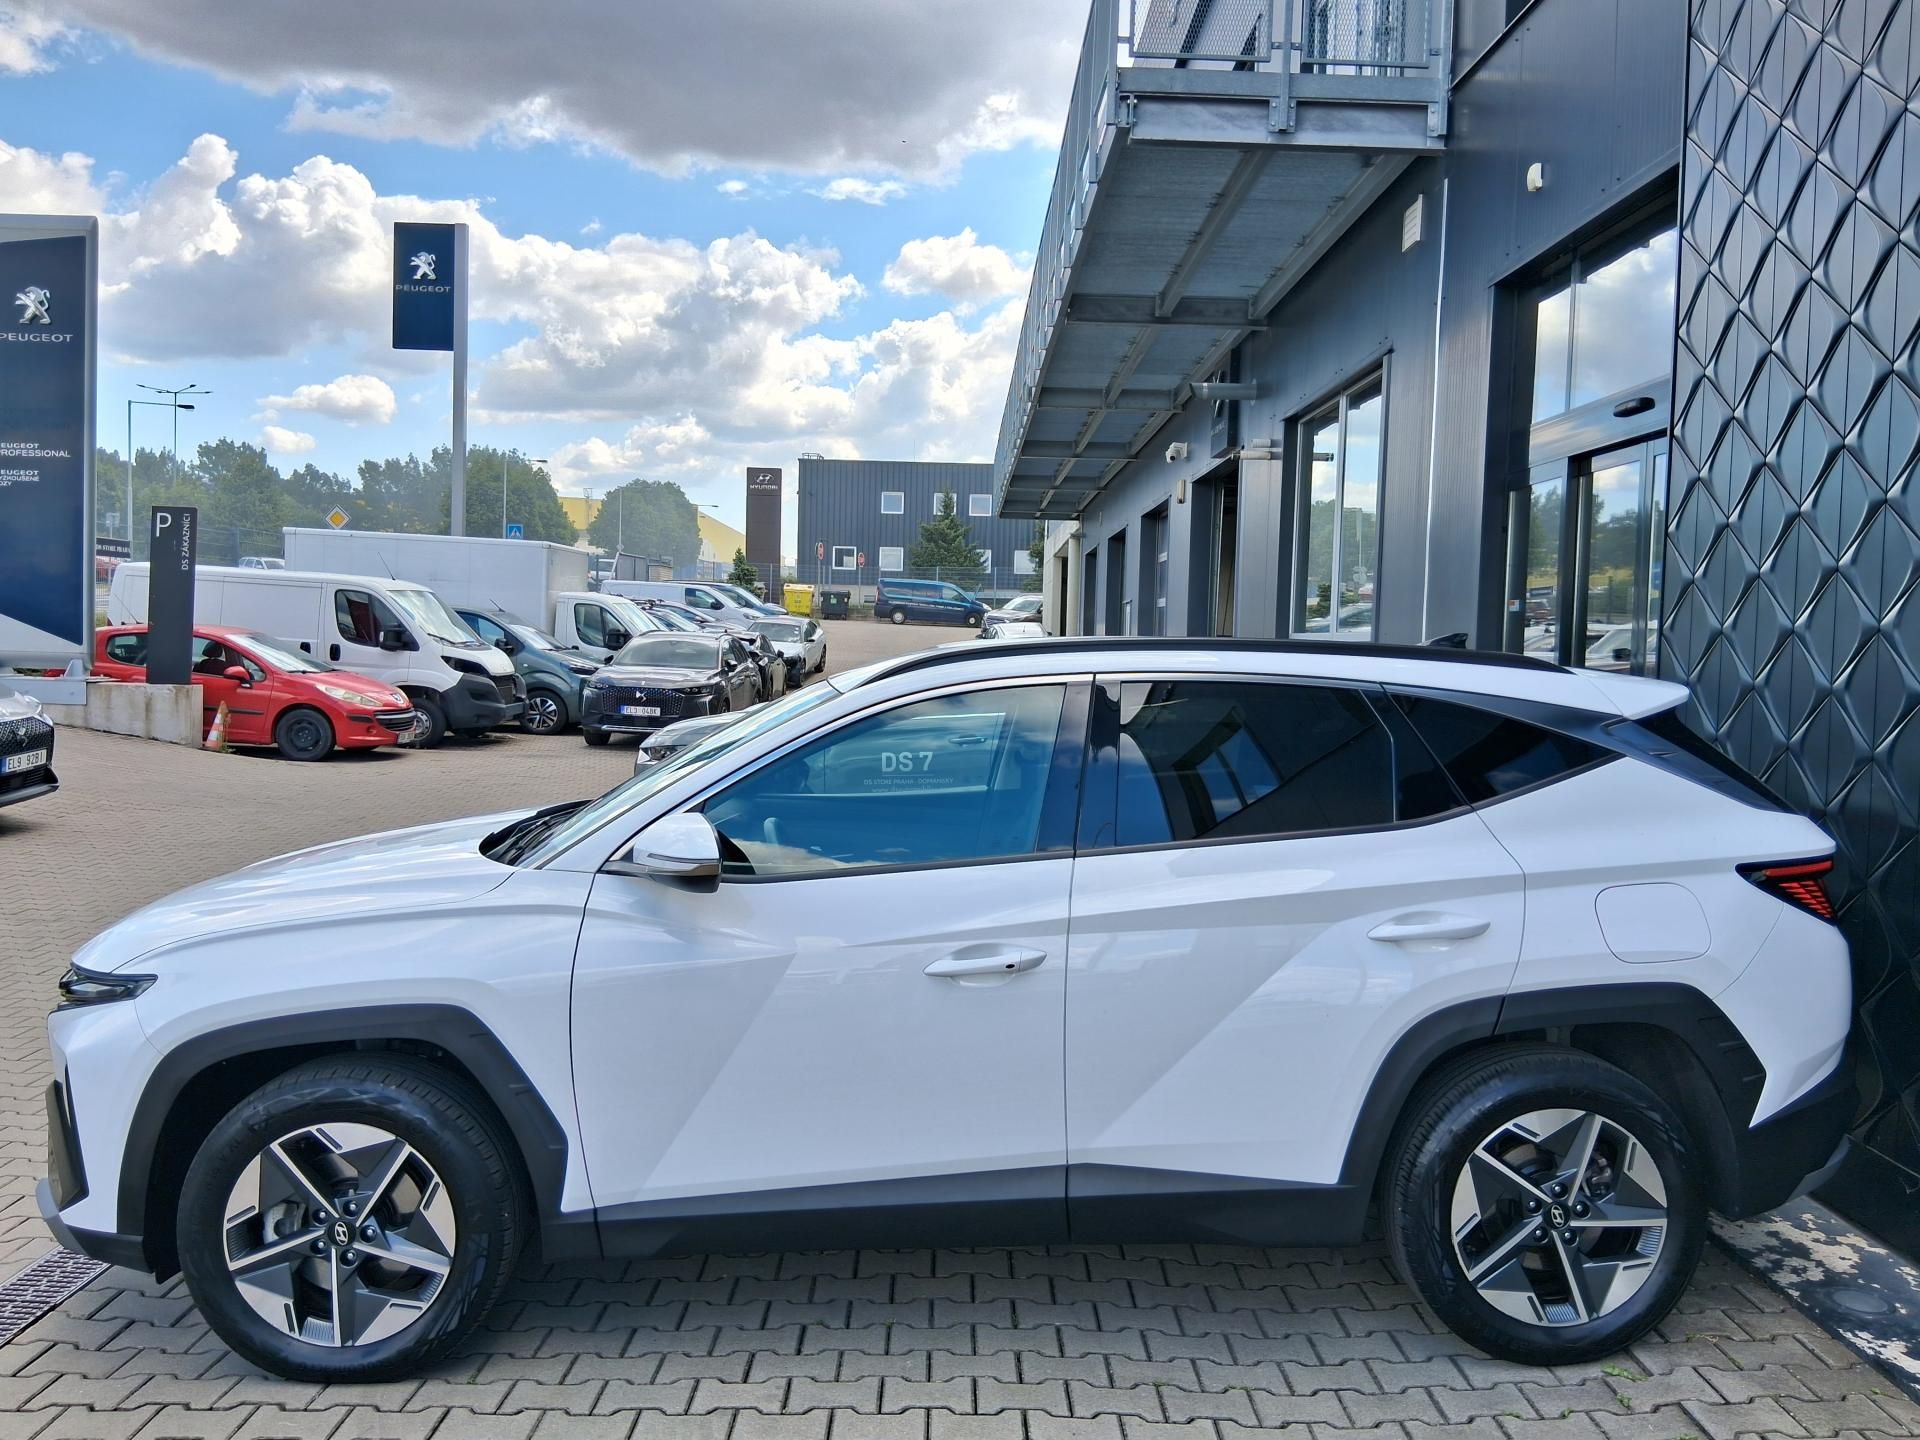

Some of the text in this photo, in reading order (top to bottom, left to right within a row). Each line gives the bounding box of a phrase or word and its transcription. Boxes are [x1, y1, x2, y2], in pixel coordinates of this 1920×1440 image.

[395, 284, 451, 293] PEUGEOT
[0, 332, 73, 342] PEUGEOT
[0, 449, 71, 458] ROFESSIONAL
[156, 512, 172, 537] P
[181, 559, 189, 570] DS
[8, 757, 22, 770] EL9
[881, 752, 933, 772] DS 7
